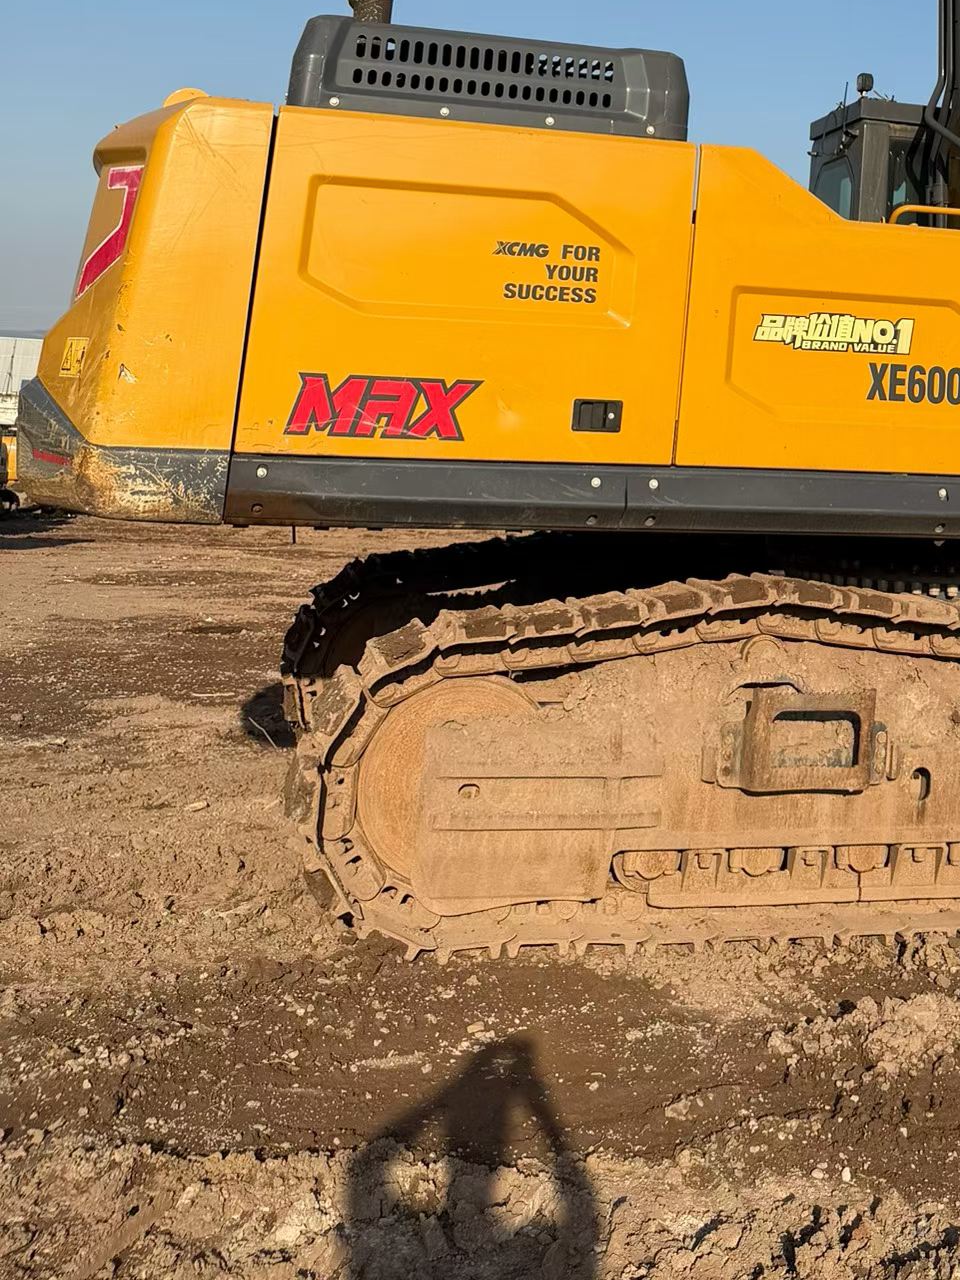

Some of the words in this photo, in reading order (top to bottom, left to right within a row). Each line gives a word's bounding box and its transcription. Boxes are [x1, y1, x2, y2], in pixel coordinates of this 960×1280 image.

[492, 241, 550, 258] XCMG
[562, 244, 601, 261] FOR
[545, 264, 599, 282] YOUR
[503, 283, 597, 303] SUCCESS
[801, 340, 848, 352] BRAND
[853, 342, 897, 354] VALUE
[283, 371, 485, 442] MAX
